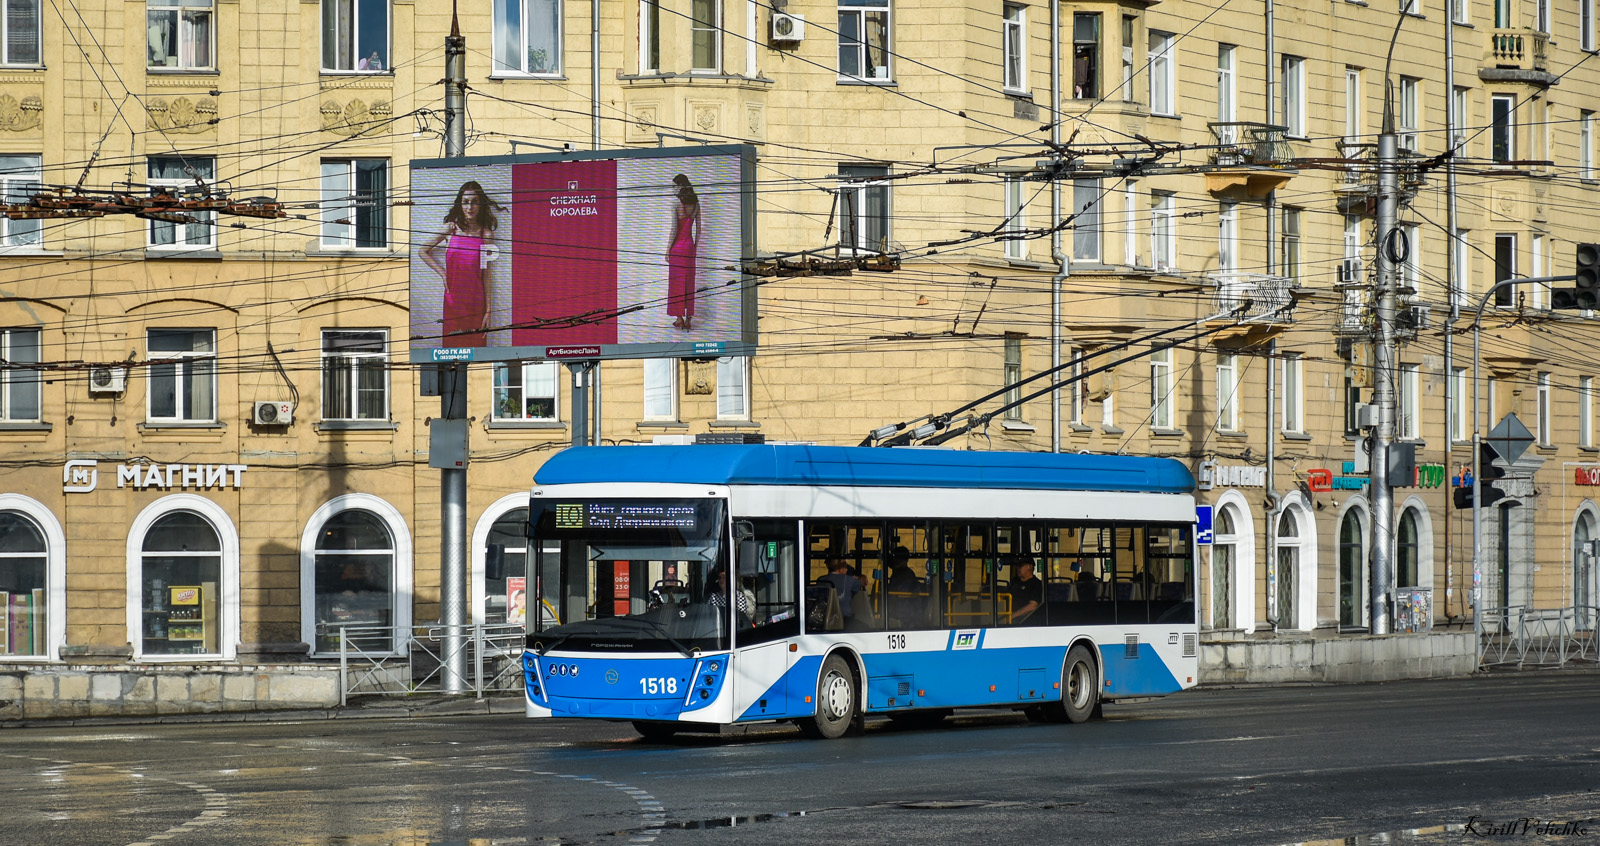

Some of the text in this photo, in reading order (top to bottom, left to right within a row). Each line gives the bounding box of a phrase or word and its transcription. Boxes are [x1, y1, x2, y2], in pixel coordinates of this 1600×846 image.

[550, 195, 597, 205] СНЕЖНАЯ
[550, 207, 598, 217] КОРОЛЕВА
[548, 348, 599, 356] АртБизнесЛайн
[117, 464, 248, 487] МАГНИТ
[886, 634, 906, 650] 1518
[639, 677, 678, 695] 1518
